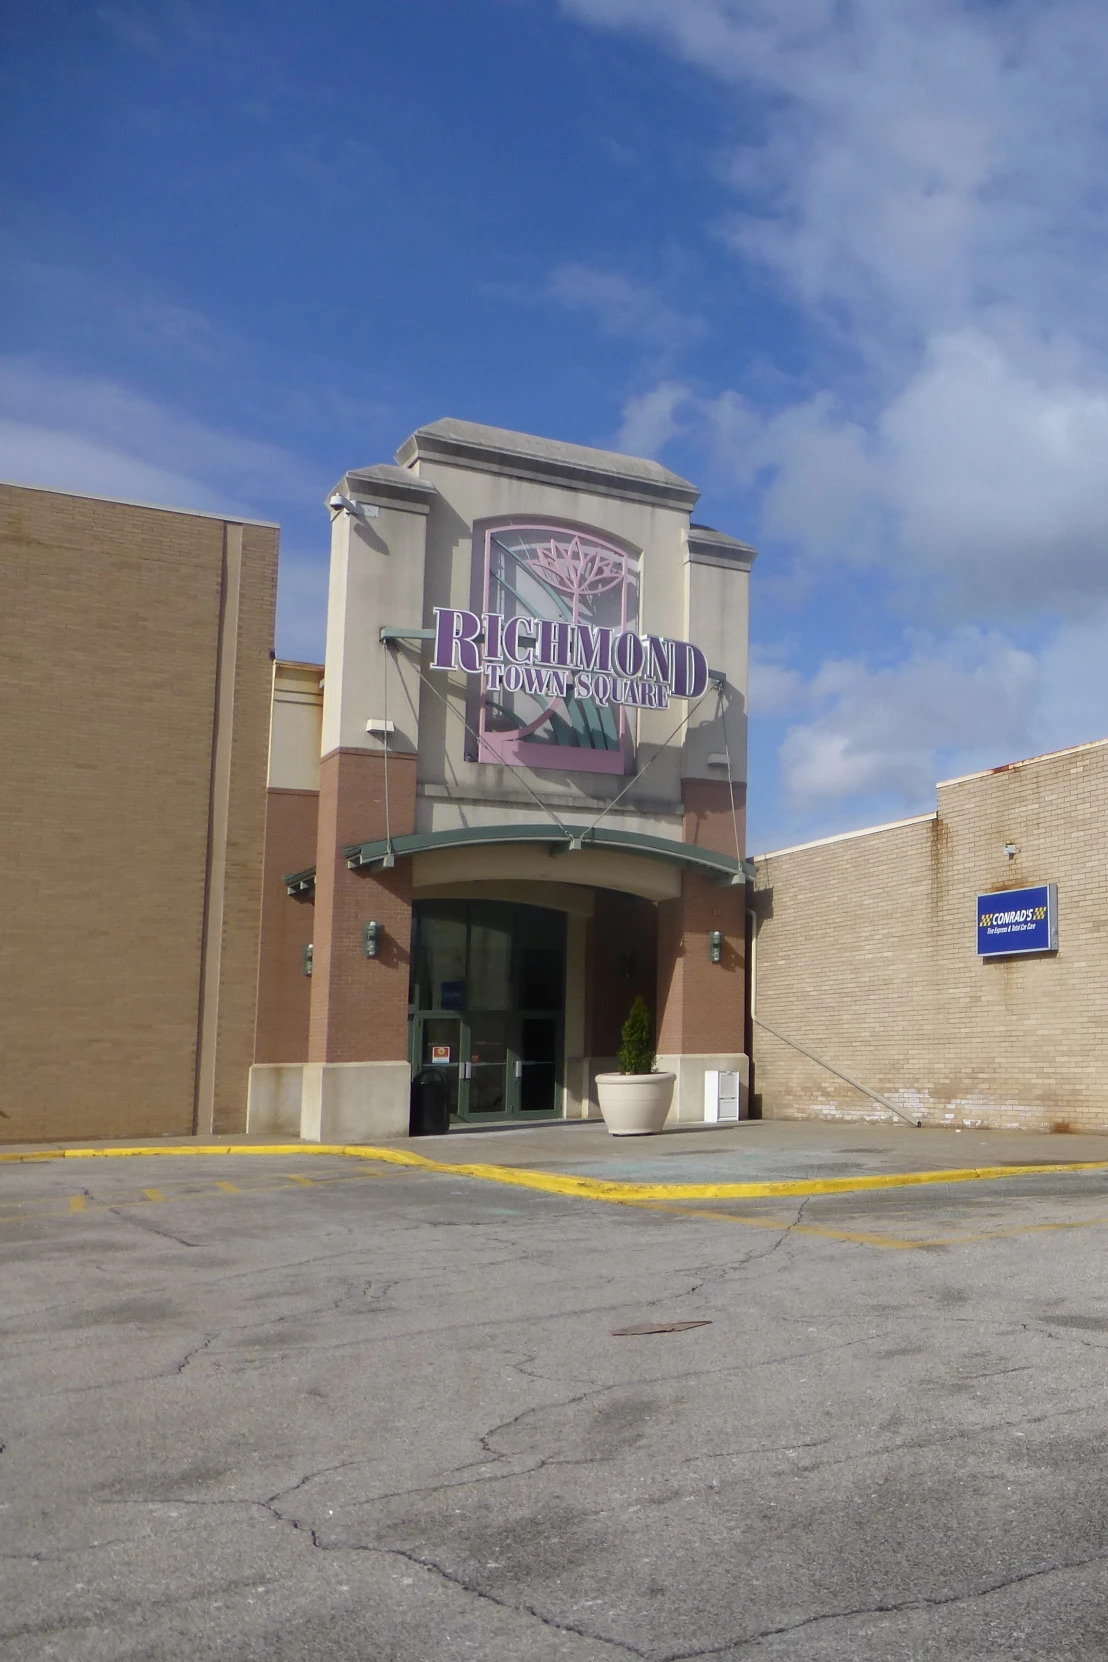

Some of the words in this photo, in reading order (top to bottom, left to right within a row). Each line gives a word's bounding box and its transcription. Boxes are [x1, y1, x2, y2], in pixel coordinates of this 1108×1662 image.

[430, 606, 709, 700] RICHMOND
[484, 663, 568, 697] TOWN
[574, 673, 670, 710] SQUARE
[993, 909, 1033, 925] CONRAD'S
